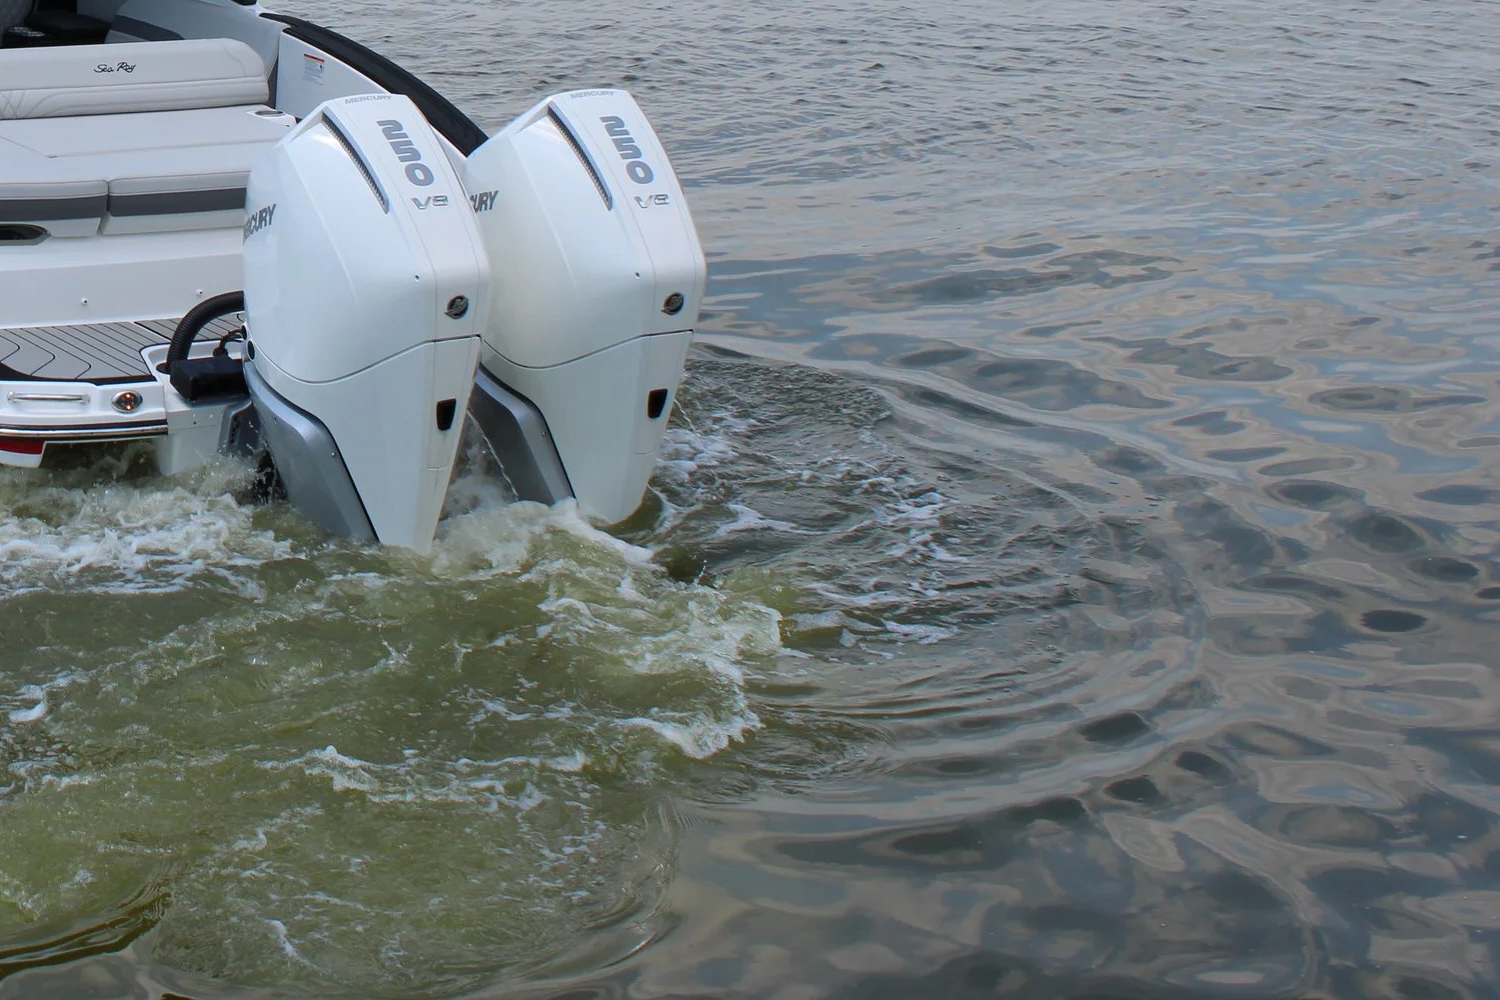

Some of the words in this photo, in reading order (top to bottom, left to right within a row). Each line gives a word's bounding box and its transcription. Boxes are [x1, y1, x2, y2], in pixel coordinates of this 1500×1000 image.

[93, 63, 115, 74] Sea
[116, 61, 137, 74] Ray
[344, 95, 393, 105] MERCURY
[569, 90, 615, 100] MERCURY
[376, 119, 435, 187] 250
[599, 115, 655, 185] 250
[411, 194, 449, 211] V8
[634, 193, 669, 209] V8
